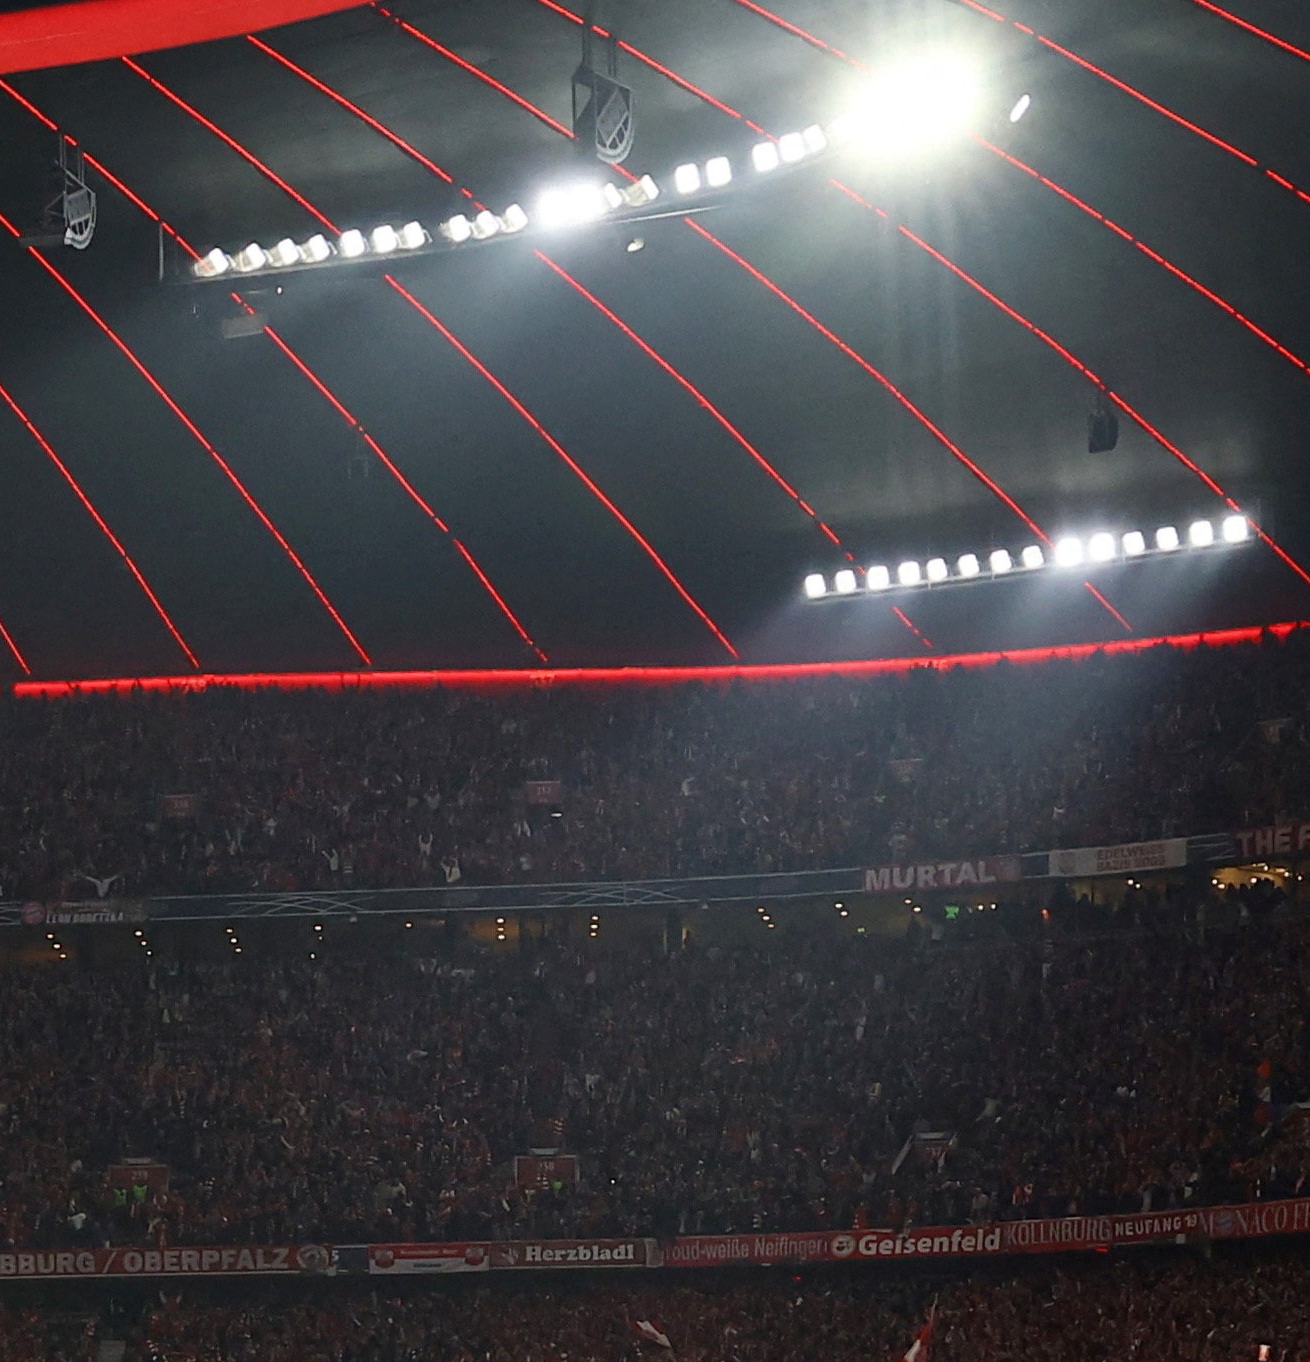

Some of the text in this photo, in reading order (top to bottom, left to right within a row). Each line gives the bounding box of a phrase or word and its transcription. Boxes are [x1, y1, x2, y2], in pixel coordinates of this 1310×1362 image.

[1236, 826, 1291, 858] THE
[864, 860, 997, 891] MURTAL
[1114, 1218, 1181, 1237] NEUFANG
[524, 1243, 634, 1262] Herzbladl
[858, 1228, 1001, 1257] Geisenfeld
[122, 1248, 290, 1273] OBERPFALZ
